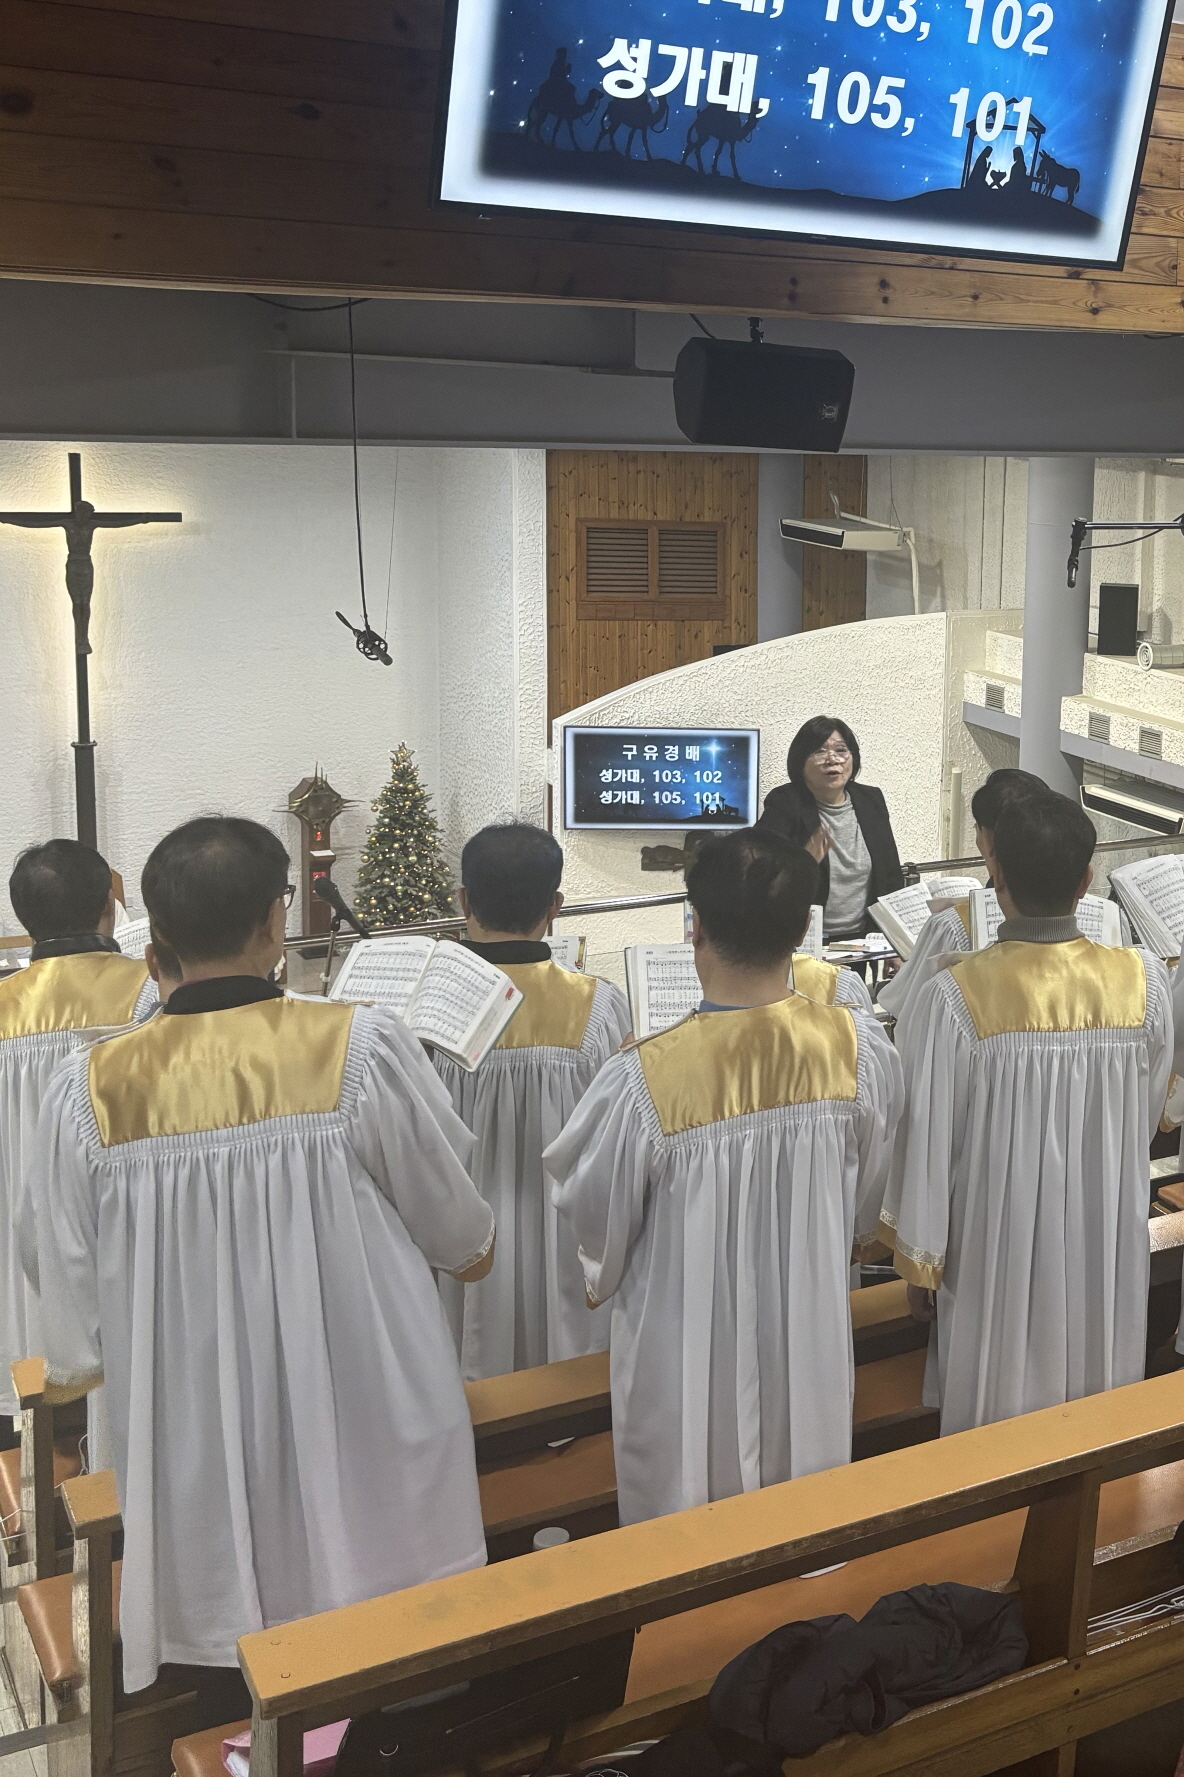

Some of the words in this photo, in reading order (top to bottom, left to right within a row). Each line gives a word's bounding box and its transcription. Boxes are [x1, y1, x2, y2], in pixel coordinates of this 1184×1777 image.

[965, 0, 1054, 55] 102
[597, 37, 771, 119] 성가대,
[807, 66, 915, 137] 105,
[949, 87, 1033, 146] 101
[599, 769, 645, 784] 성가대,
[652, 769, 686, 785] 103,
[694, 770, 723, 784] 102
[599, 790, 645, 805] 성가대,
[652, 791, 686, 806] 105,
[694, 791, 721, 805] 101
